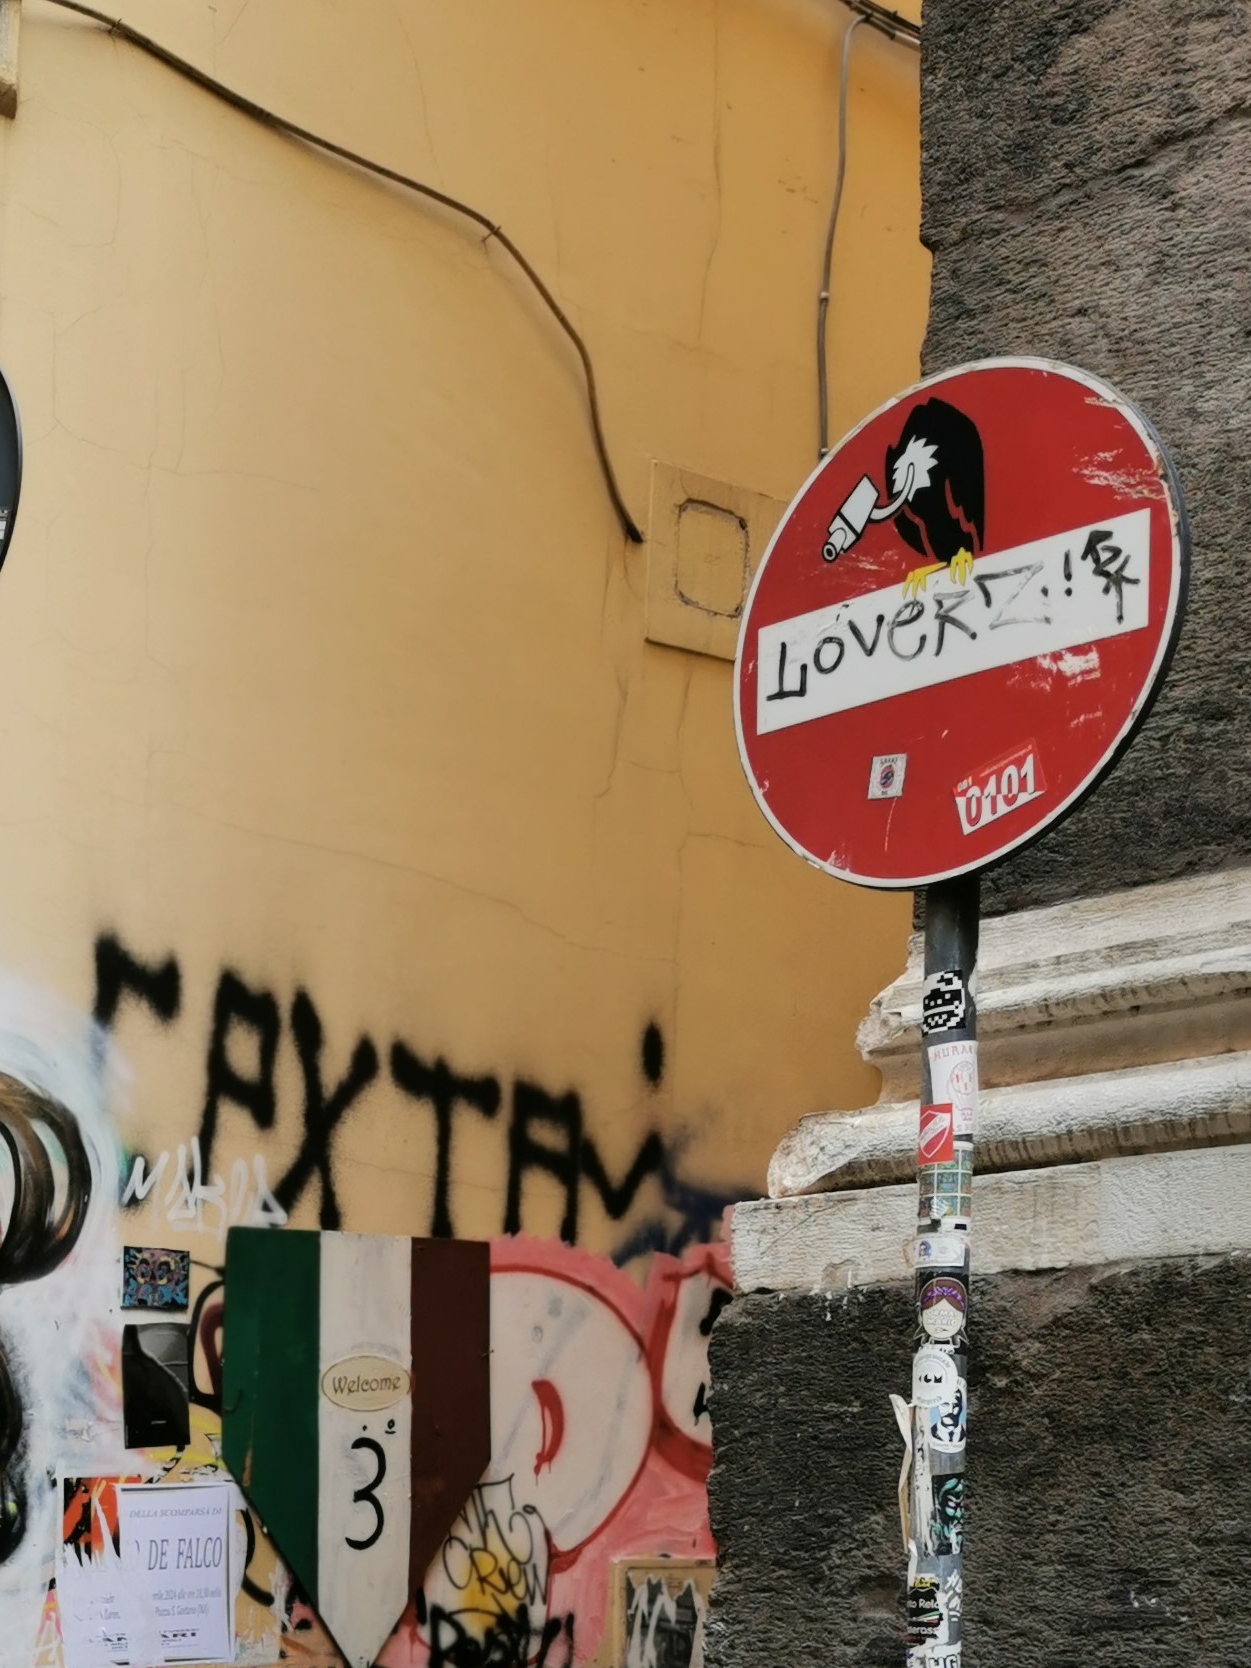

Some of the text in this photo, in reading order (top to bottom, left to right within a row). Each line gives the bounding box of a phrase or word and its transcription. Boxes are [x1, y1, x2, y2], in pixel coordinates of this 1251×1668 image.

[965, 752, 1036, 827] 0101
[332, 1374, 402, 1396] Welcome
[148, 1536, 223, 1571] DE FALCO
